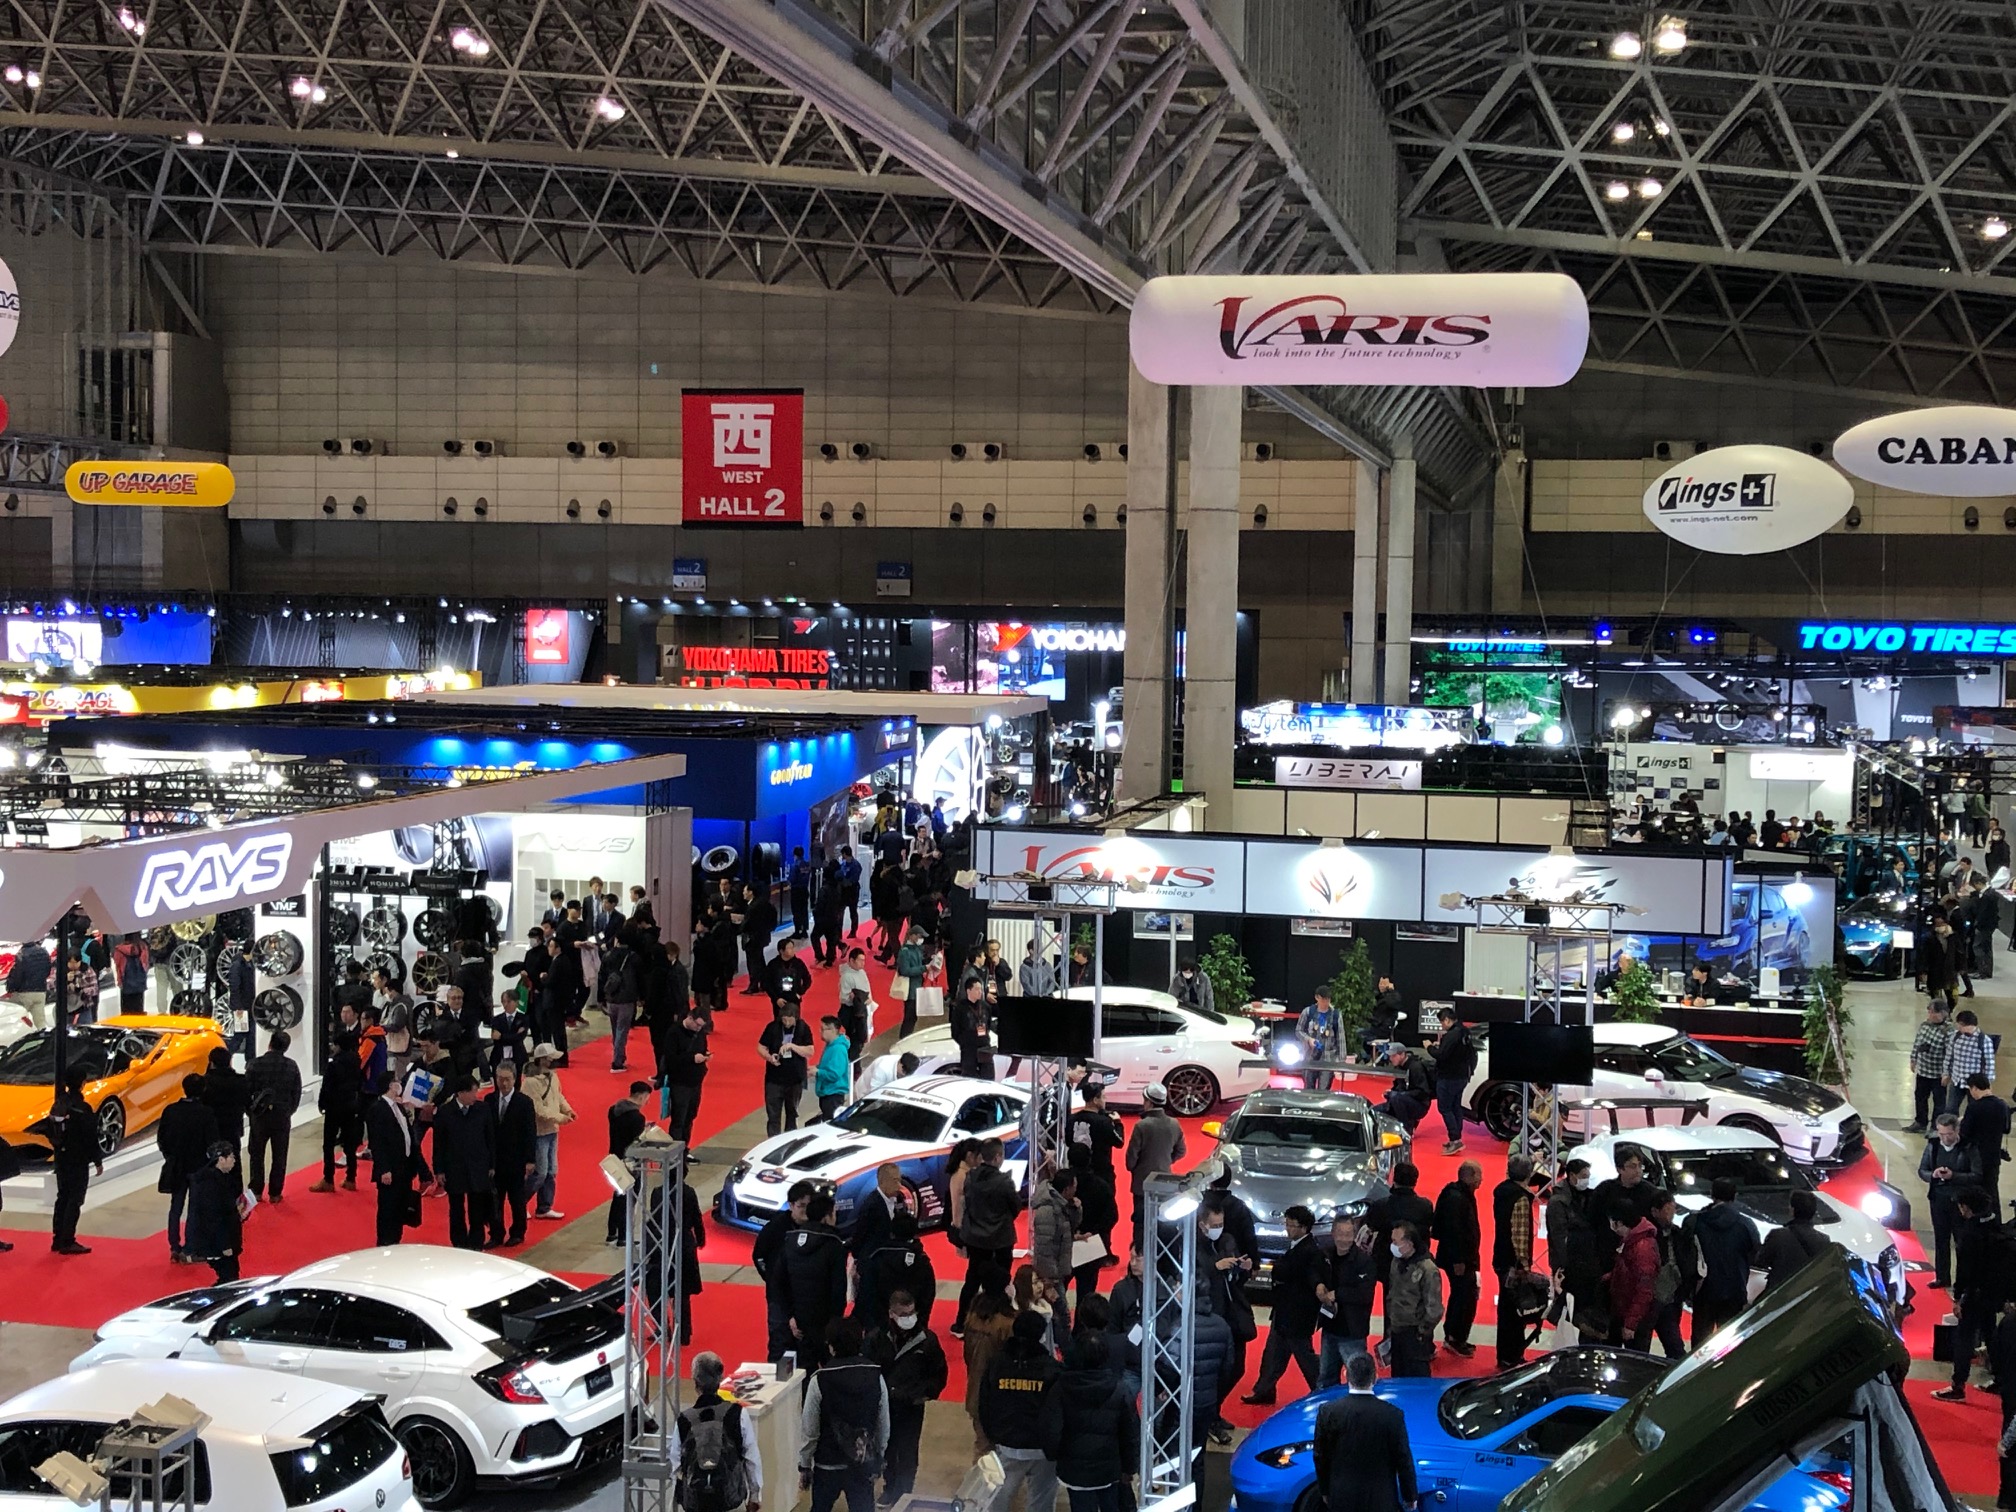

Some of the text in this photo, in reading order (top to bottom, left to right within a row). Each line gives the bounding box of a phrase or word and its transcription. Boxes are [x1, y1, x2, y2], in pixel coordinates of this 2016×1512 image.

[1213, 295, 1492, 360] VARIS
[1253, 348, 1461, 360] look into the future technology
[710, 403, 775, 469] 西
[79, 472, 198, 495] UP GARAGE
[722, 471, 764, 484] WEST
[700, 488, 786, 517] HALL 2
[1670, 515, 1758, 523] www.ings-net.com
[693, 562, 701, 573] 2
[899, 566, 906, 577] 2
[1031, 628, 1126, 652] YOKOHA
[1801, 626, 2016, 654] TOYO TIRES
[682, 646, 829, 675] YOKOHAMA TIRES
[1900, 714, 1927, 724] TOYO
[771, 760, 813, 787] GOODYEAR
[134, 832, 292, 918] RAYS
[998, 1378, 1044, 1392] SECURITY
